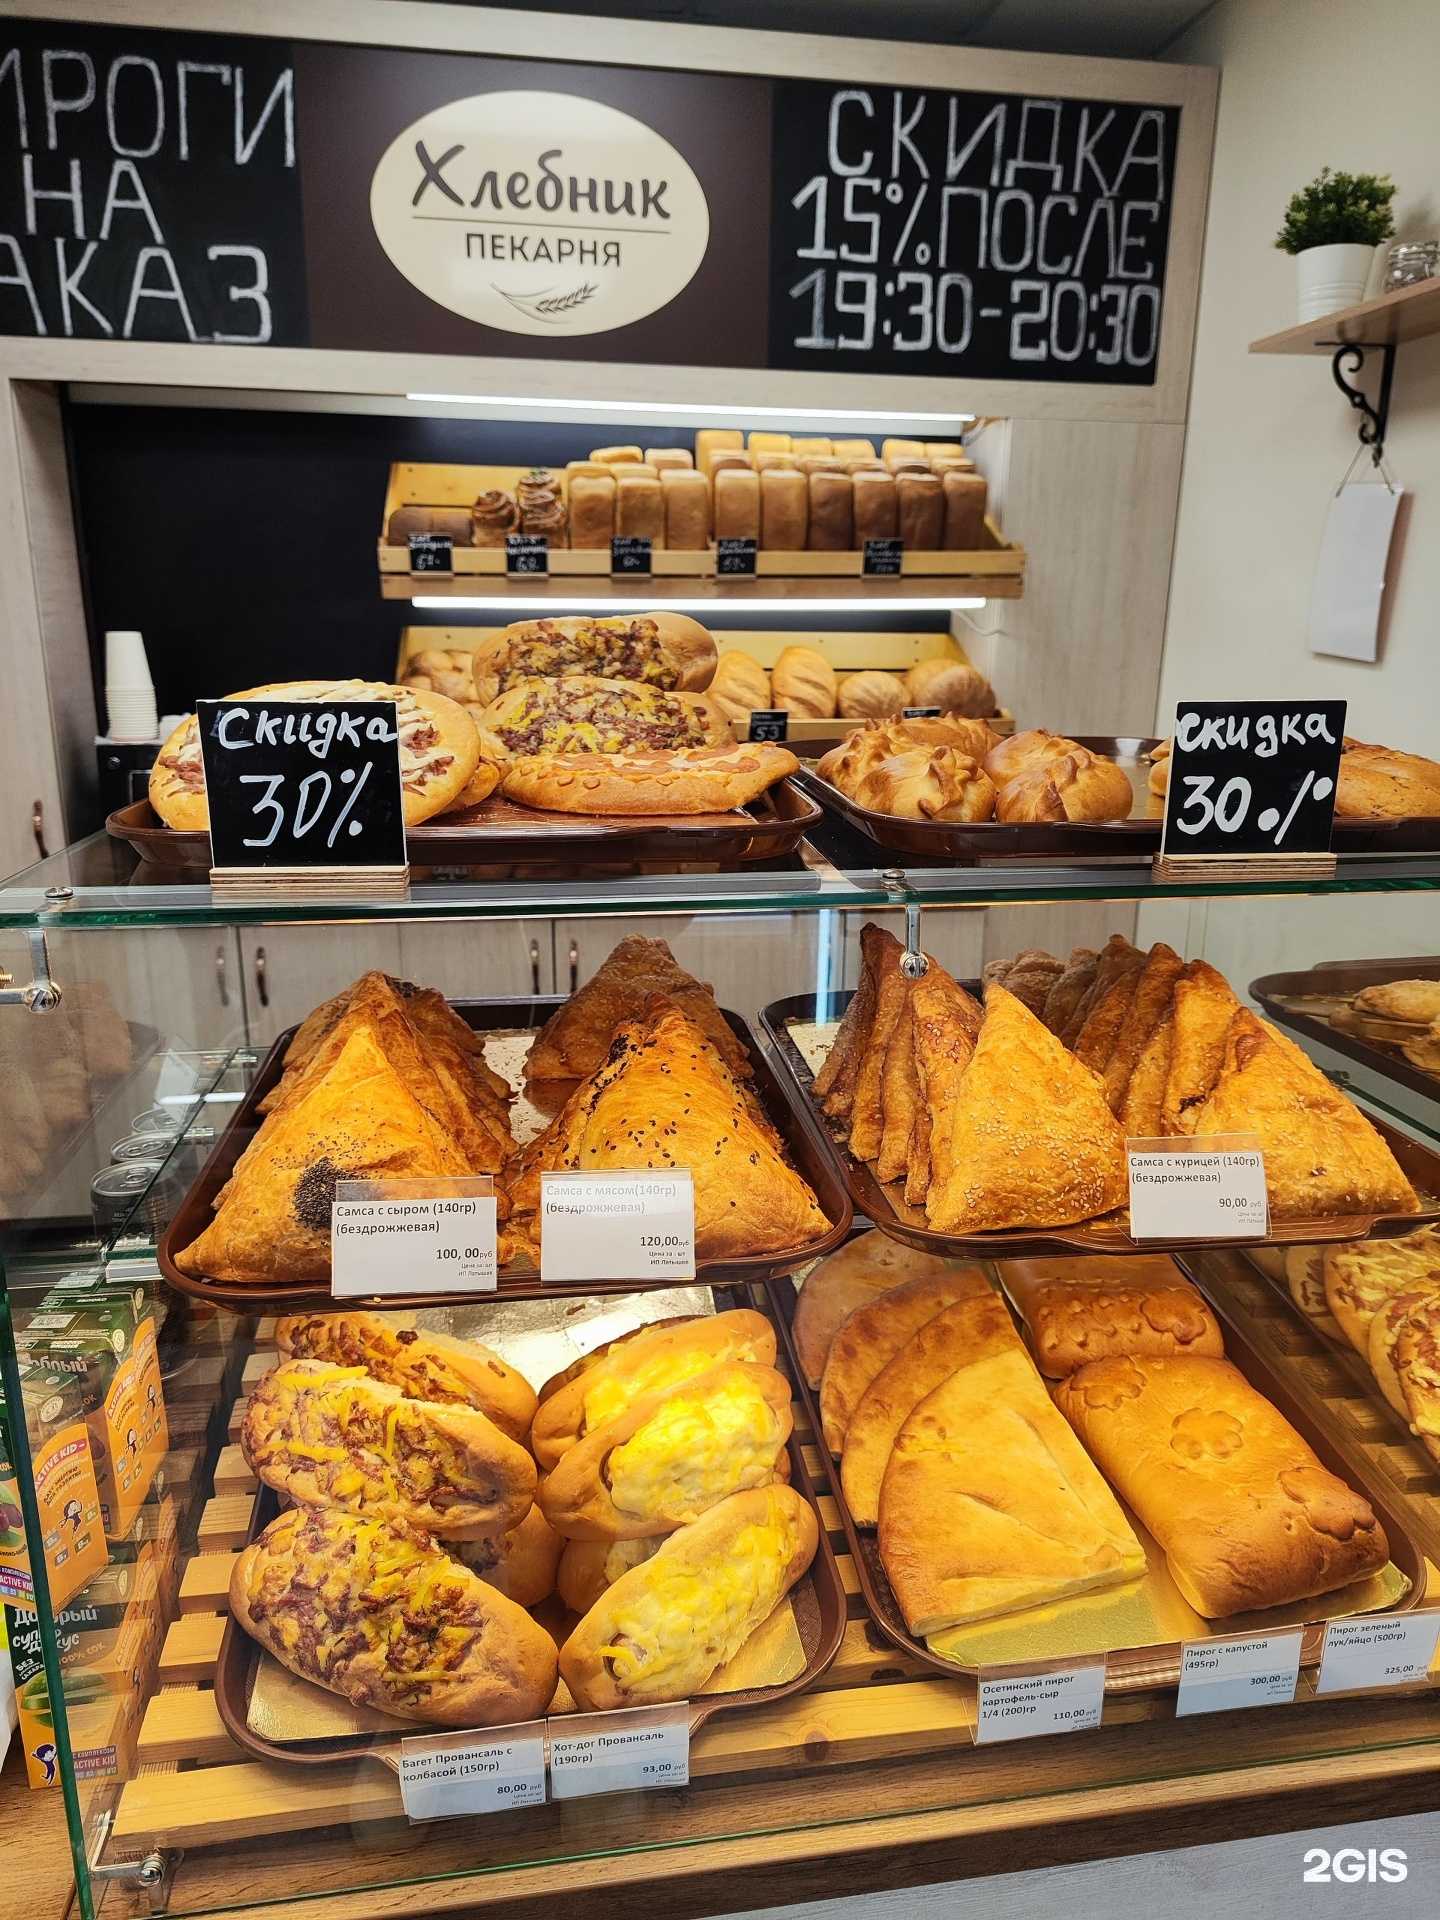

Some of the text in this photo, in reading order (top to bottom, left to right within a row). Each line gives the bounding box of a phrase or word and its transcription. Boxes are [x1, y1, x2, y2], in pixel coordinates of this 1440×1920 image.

[829, 91, 1165, 200] СКИДКА
[412, 140, 671, 219] Хлебник
[23, 154, 165, 245] НА
[939, 187, 1159, 280] ПОСЛЕ
[466, 232, 620, 267] ПЕКАРНЯ
[789, 268, 1159, 366] 19:30-20:30
[218, 707, 400, 759] Скидка
[239, 761, 373, 848] 30%
[1130, 1157, 1163, 1167] Самса
[1175, 1156, 1220, 1168] курицей
[1223, 1156, 1260, 1168] (140гр)
[1132, 1172, 1221, 1184] (бездрожжевая)
[546, 1185, 583, 1196] Самса
[586, 1187, 592, 1196] с
[337, 1201, 476, 1218] Самса с сыром (140гр)
[546, 1201, 646, 1215] (бездрожжевая)
[1219, 1198, 1247, 1209] 90,00
[336, 1220, 440, 1236] (бездрожжевая)
[14, 1604, 98, 1628] Дорый
[1330, 1621, 1401, 1635] Пирог зеленый
[1328, 1632, 1406, 1647] лук/яйцо (500гр)
[1186, 1648, 1216, 1658] Пирог
[1225, 1641, 1268, 1654] капустой
[1185, 1659, 1219, 1671] (495гр)
[1384, 1664, 1414, 1675] 325,00
[983, 1675, 1075, 1694] Осетинский пирог
[1250, 1675, 1280, 1686] 300,00
[982, 1690, 1059, 1706] картофель-сыр
[981, 1705, 1037, 1719] 1/4 (200)гр
[1053, 1709, 1085, 1720] 110,00
[554, 1732, 664, 1752] Хот-дог Провансаль
[73, 1757, 101, 1769] ACTIVE
[402, 1756, 432, 1769] Багет
[435, 1750, 504, 1766] Провансаль
[554, 1753, 593, 1766] (190гр)
[403, 1761, 500, 1782] колбасой (150гр)
[642, 1763, 672, 1774] 93,00
[497, 1783, 527, 1794] 80,00
